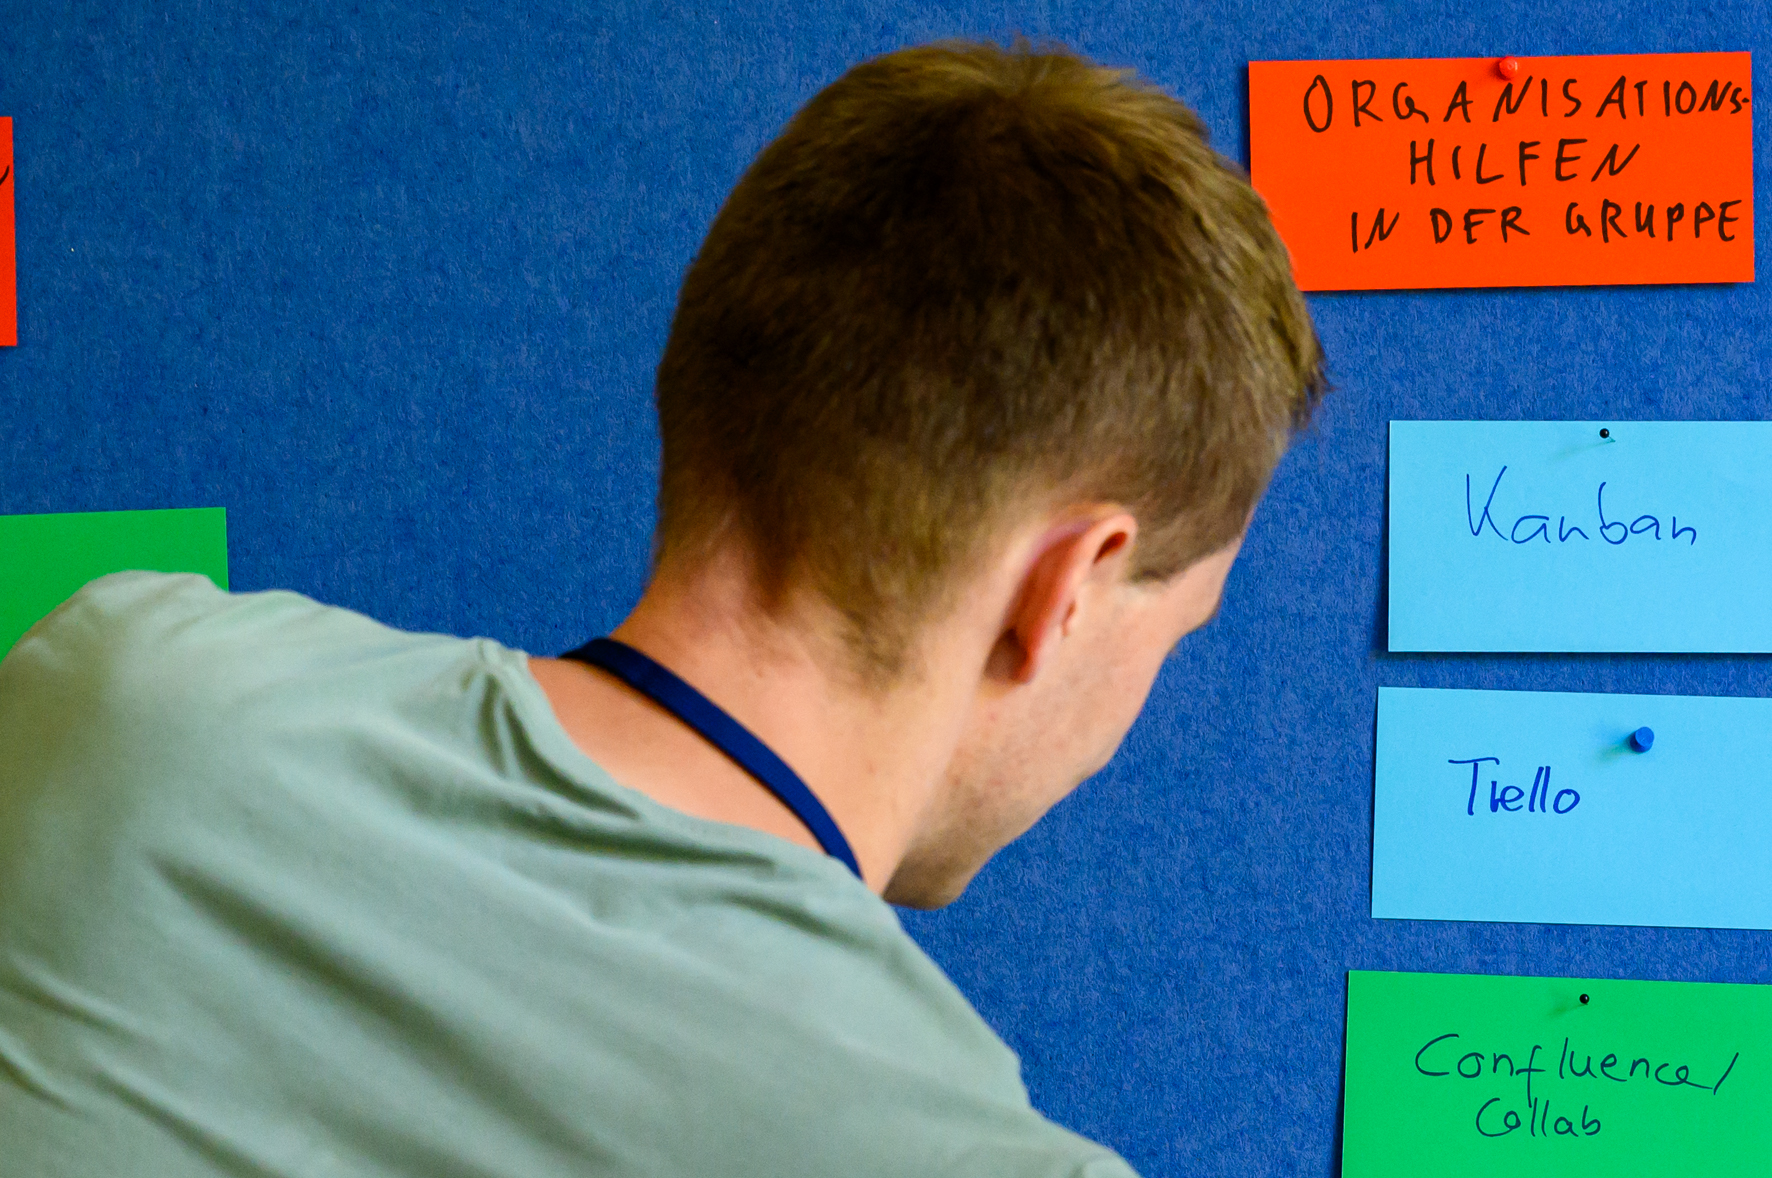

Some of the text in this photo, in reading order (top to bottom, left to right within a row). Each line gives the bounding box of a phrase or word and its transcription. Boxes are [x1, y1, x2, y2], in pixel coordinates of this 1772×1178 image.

[1302, 73, 1751, 134] ORGANISATIONS-
[1409, 137, 1641, 187] HILFEN
[1350, 198, 1744, 254] IN DER GRUPPE
[1465, 464, 1699, 546] Kanban
[1447, 756, 1581, 817] Trello
[1475, 1097, 1603, 1138] Collab
